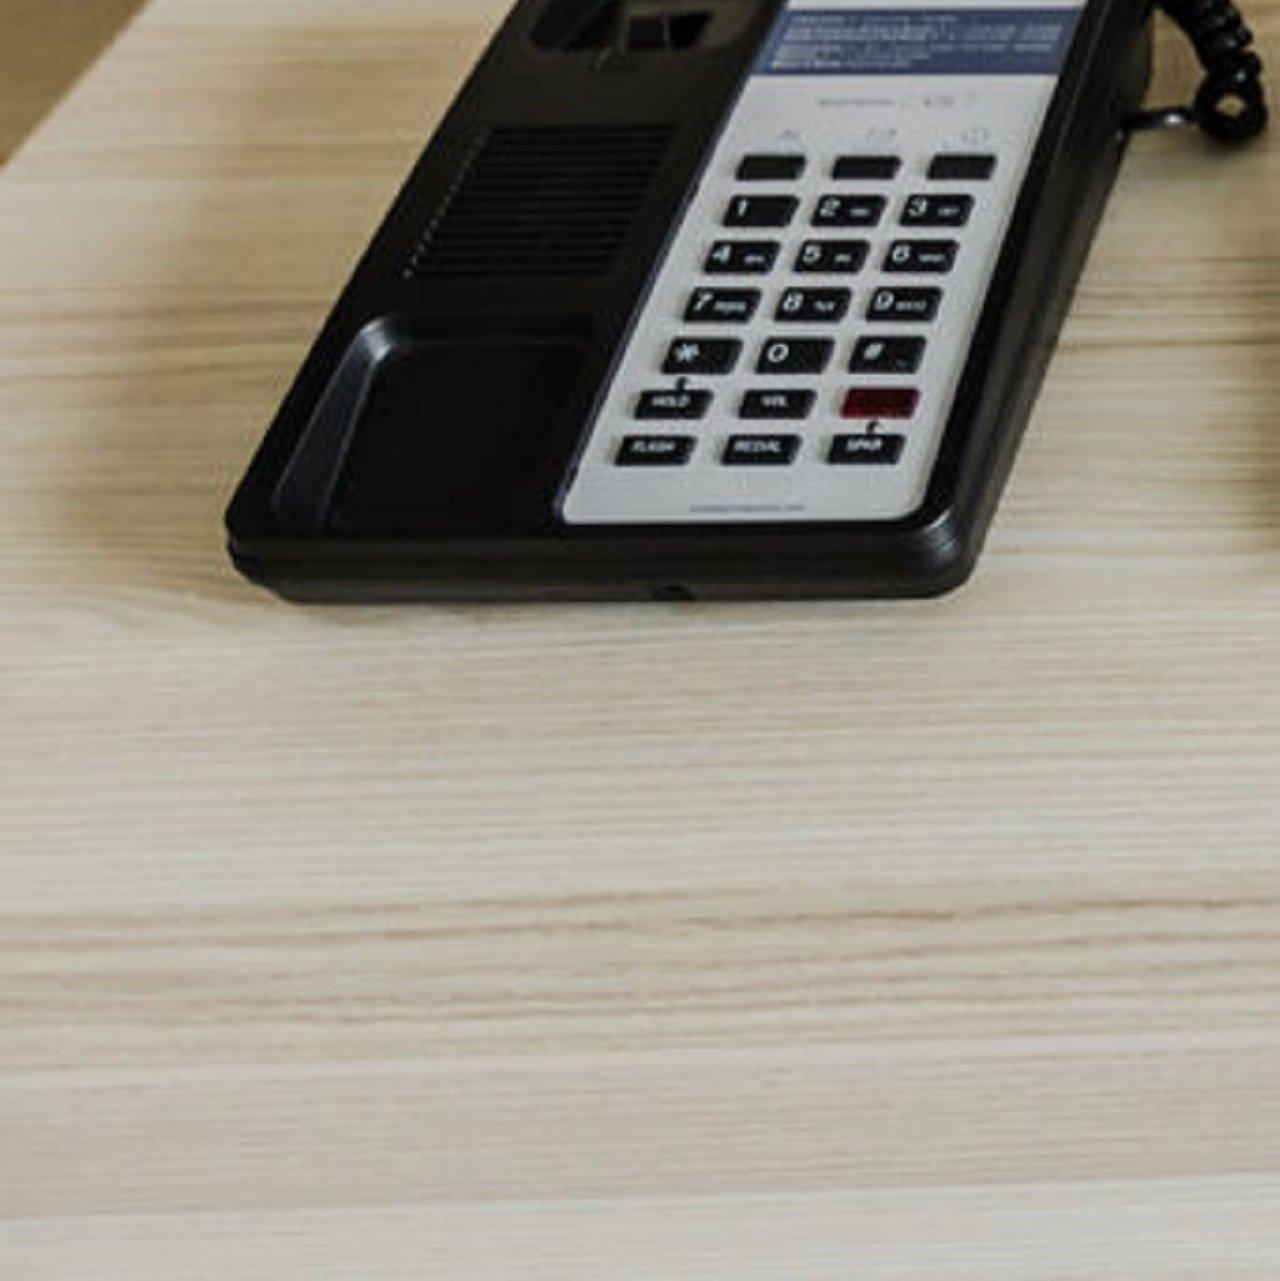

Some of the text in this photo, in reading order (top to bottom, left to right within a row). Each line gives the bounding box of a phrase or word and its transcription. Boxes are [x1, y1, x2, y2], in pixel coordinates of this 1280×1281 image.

[735, 199, 748, 218] 1
[819, 199, 842, 218] 2
[908, 198, 928, 217] 3
[712, 245, 731, 263] 4
[802, 244, 821, 263] 5
[892, 244, 911, 262] 6
[694, 292, 714, 311] 7
[783, 292, 803, 311] 8
[874, 290, 895, 310] 9
[767, 342, 789, 363] 0
[630, 440, 676, 453] FLASH
